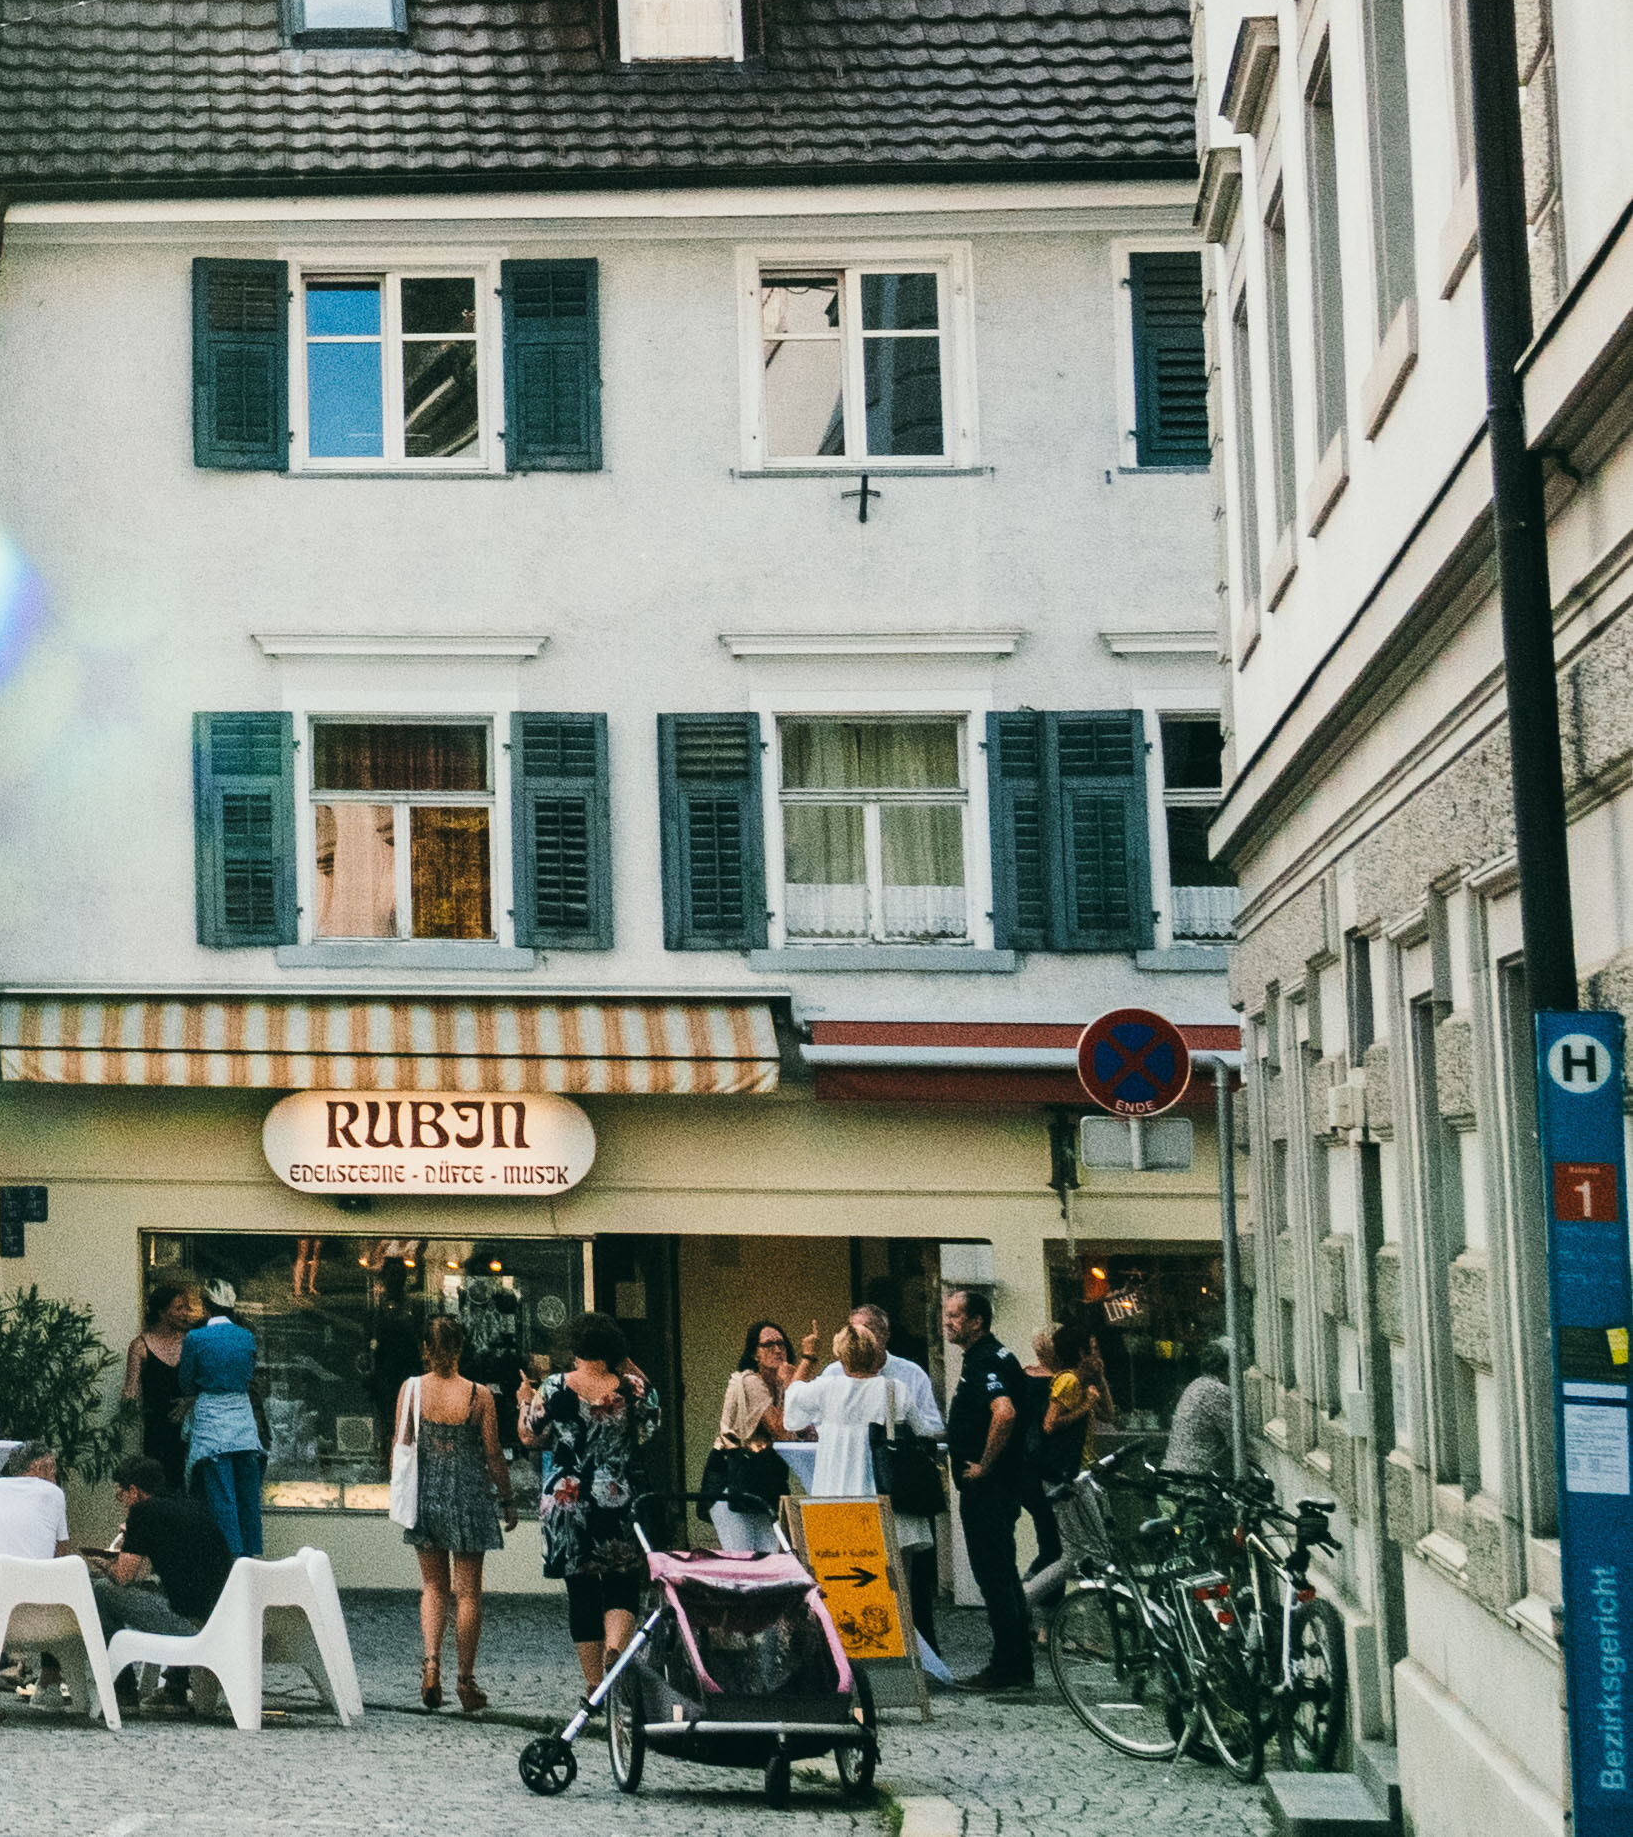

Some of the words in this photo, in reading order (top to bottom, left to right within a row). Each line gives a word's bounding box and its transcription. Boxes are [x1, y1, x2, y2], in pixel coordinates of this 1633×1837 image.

[1561, 1043, 1598, 1083] H
[325, 1100, 531, 1149] RUBIN
[1114, 1099, 1156, 1114] ENDE
[289, 1163, 406, 1184] EDELSTEINE
[424, 1160, 485, 1185] DÜFTE
[503, 1164, 570, 1186] MUSIK
[1574, 1179, 1592, 1218] 1
[1590, 1564, 1627, 1791] Bezirksgericht
